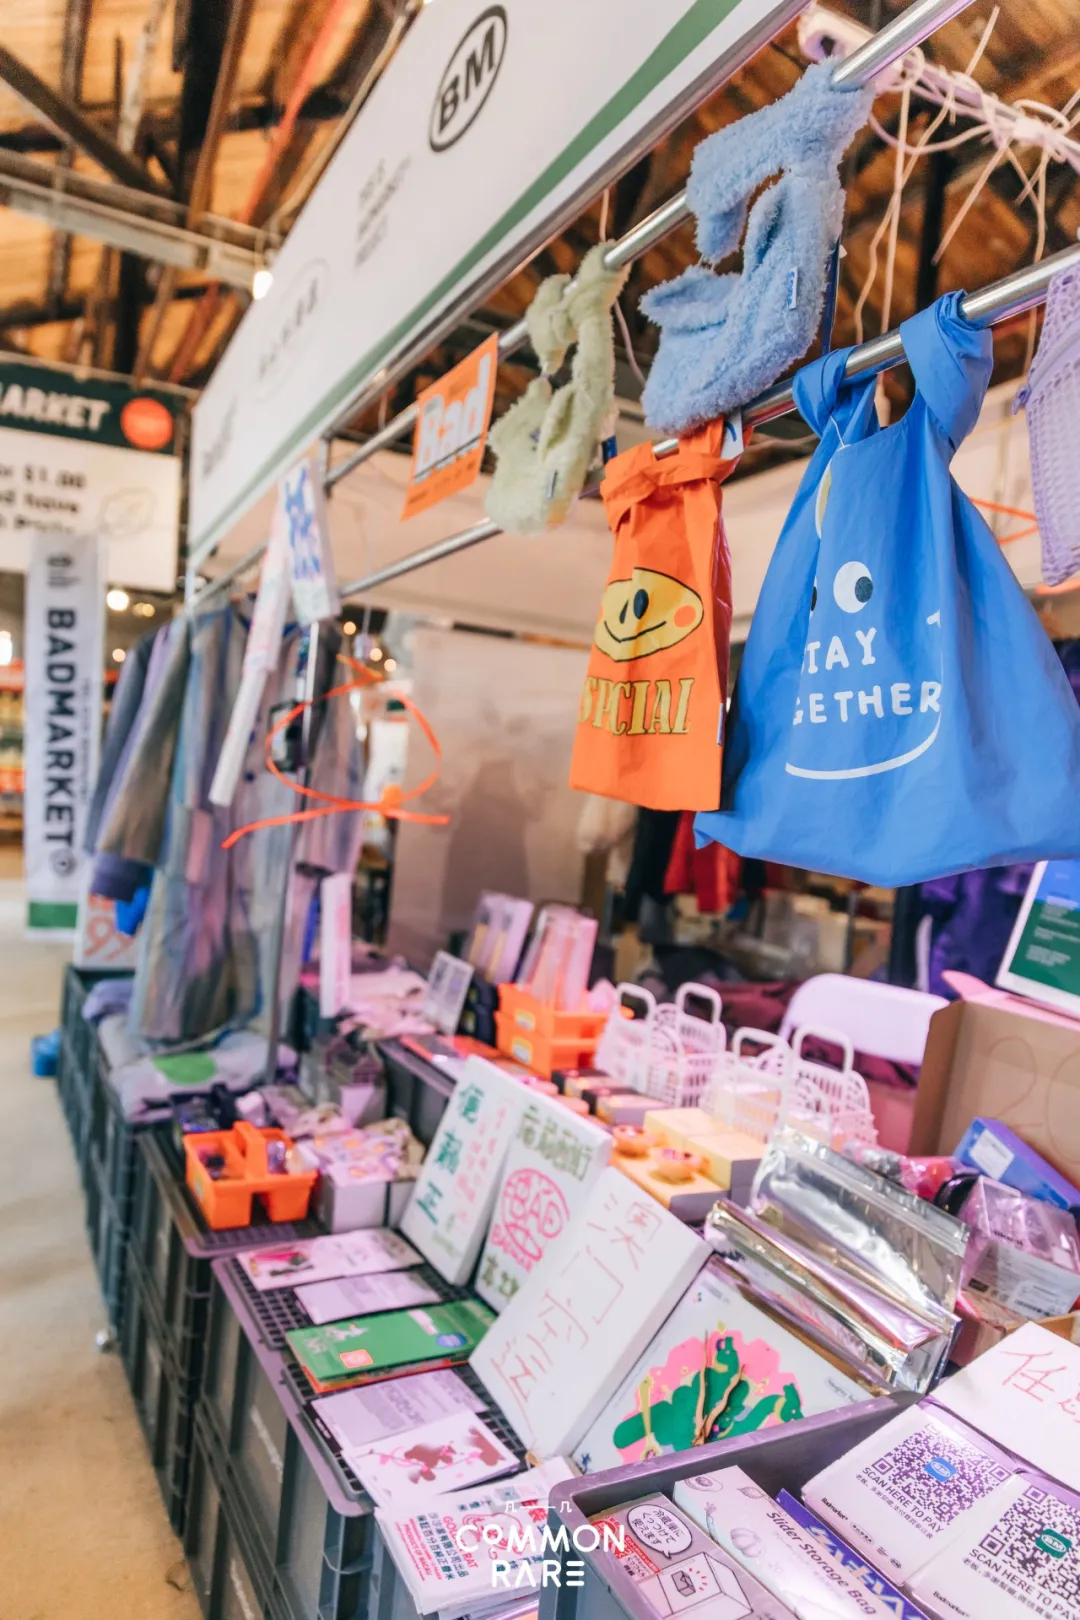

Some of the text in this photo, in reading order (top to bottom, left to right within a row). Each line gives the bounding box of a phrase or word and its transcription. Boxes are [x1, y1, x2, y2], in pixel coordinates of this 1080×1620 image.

[438, 22, 495, 134] BM
[0, 383, 111, 432] ARKET
[415, 353, 492, 482] Bad
[801, 627, 877, 676] TAY
[45, 607, 77, 849] BADMARKET
[863, 1467, 944, 1533] SCAN HERE TO PAY
[463, 1552, 479, 1568] RAT
[765, 1511, 803, 1542] Slider
[799, 1540, 850, 1588] Storage
[848, 1587, 878, 1615] Bag
[969, 1548, 1002, 1573] SCAN
[1001, 1569, 1035, 1595] HERE
[1036, 1591, 1052, 1606] TO
